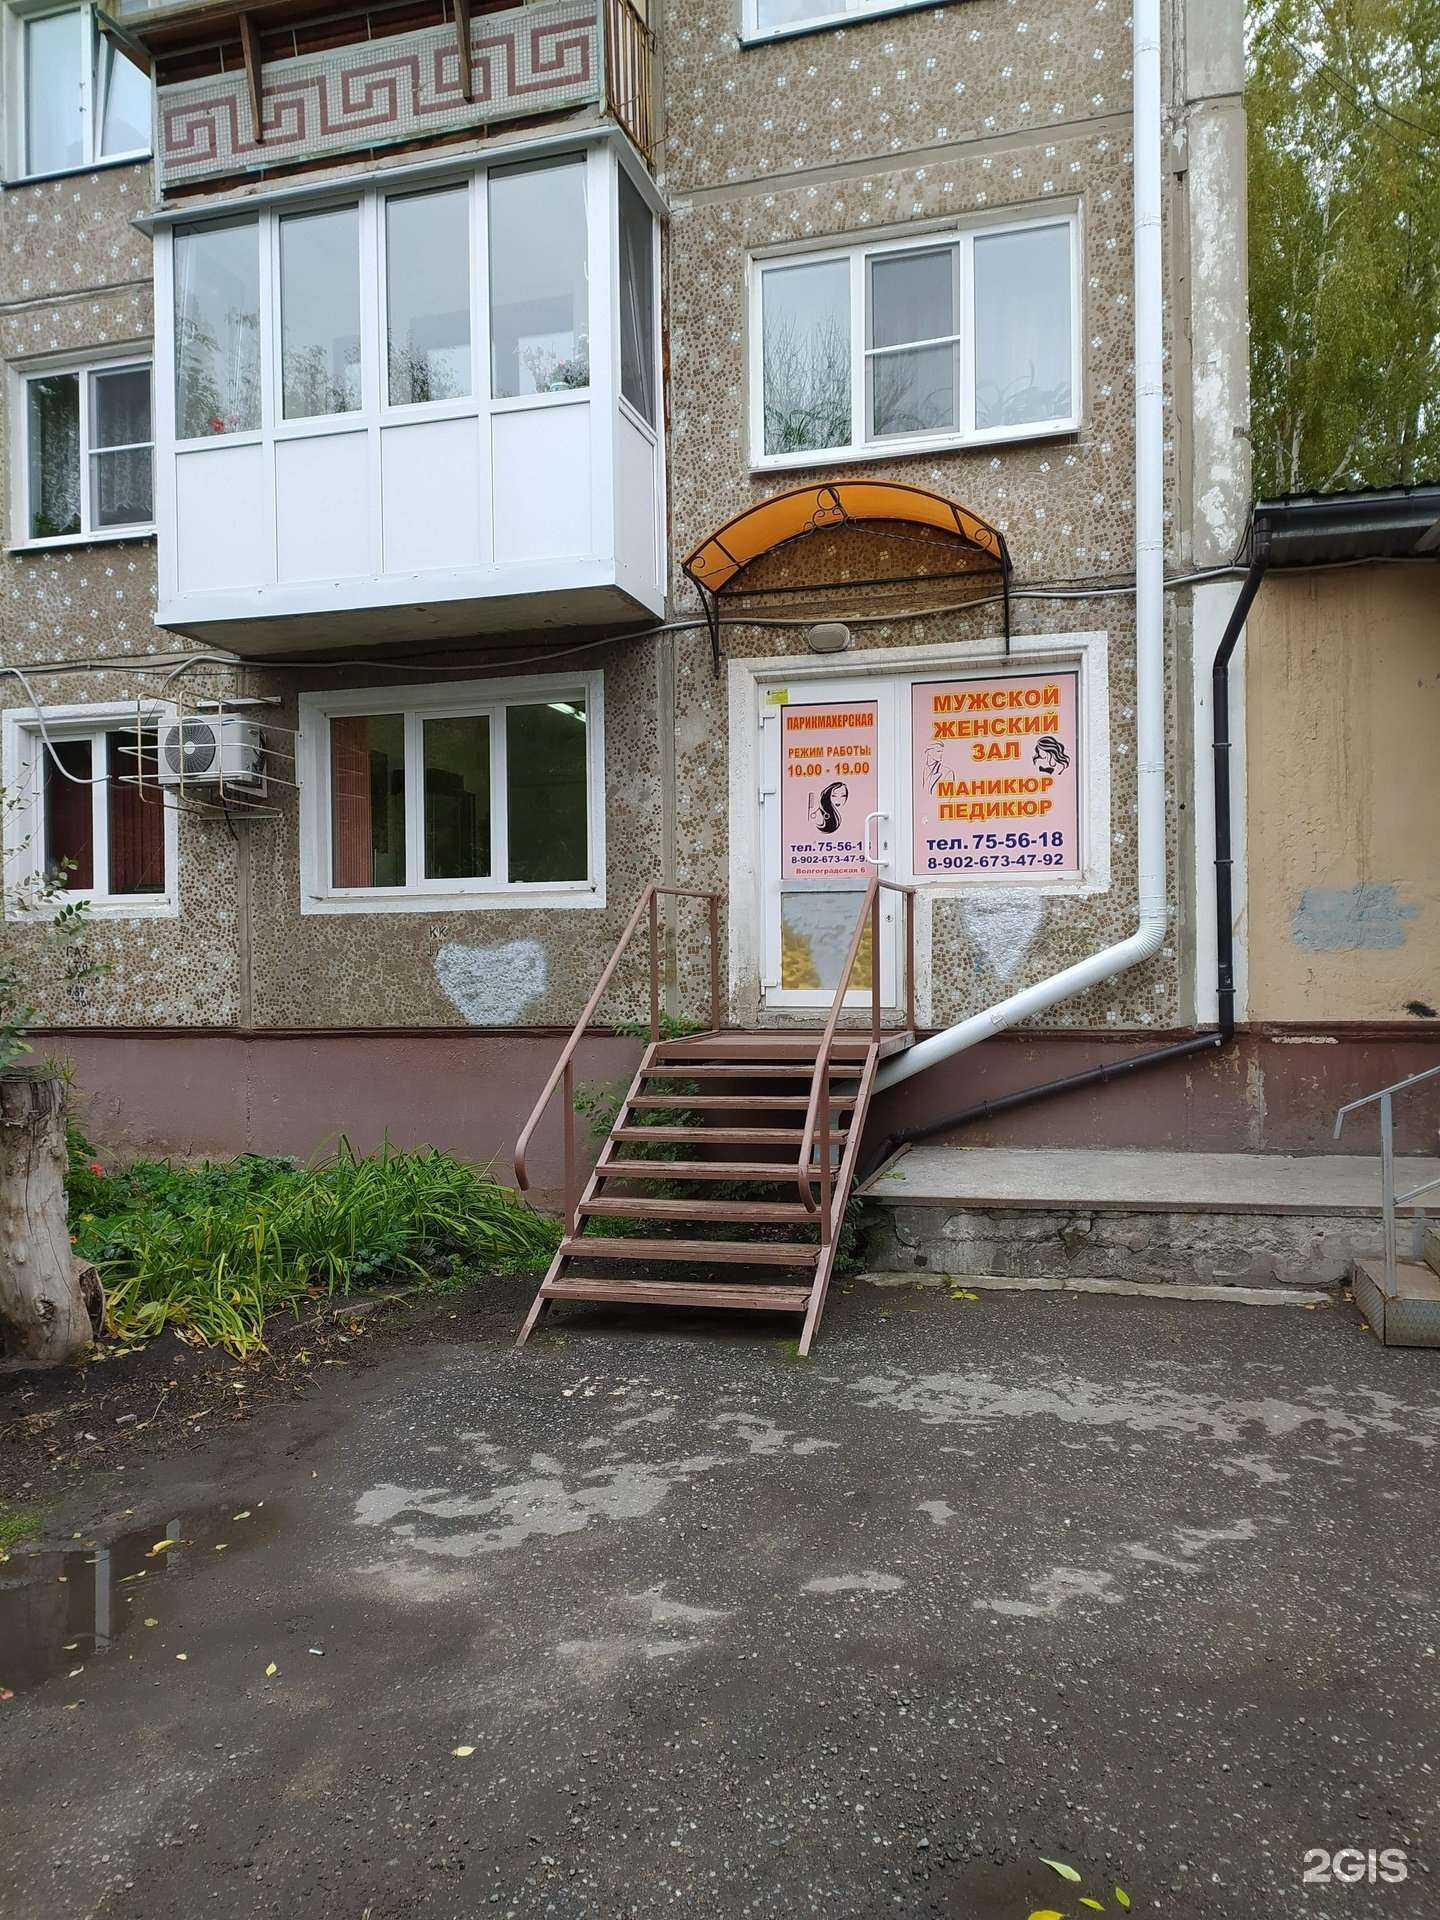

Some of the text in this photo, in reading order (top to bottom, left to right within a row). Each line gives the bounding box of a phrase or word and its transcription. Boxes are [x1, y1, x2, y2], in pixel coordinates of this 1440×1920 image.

[932, 685, 1060, 713] МУЖСКОЙ
[787, 713, 873, 731] ПАРИКМАХЕРСКАЯ
[932, 711, 1059, 740] ЖЕНСКИЙ
[788, 745, 871, 758] РЕЖИМ РАБОТЫ:
[970, 741, 1021, 762] ЗАЛ
[788, 764, 822, 777] 10.00
[835, 762, 870, 775] 19.00
[937, 777, 1055, 798] МАНИКЮР
[938, 799, 1053, 823] ПЕДИКЮР
[791, 841, 871, 853] тел. 75-56-1
[926, 831, 1063, 851] тел. 75-56-18
[791, 855, 868, 864] 8-902-673-47-9
[927, 853, 1064, 869] 8-902-673-47-92
[796, 867, 859, 875] Волгоградская
